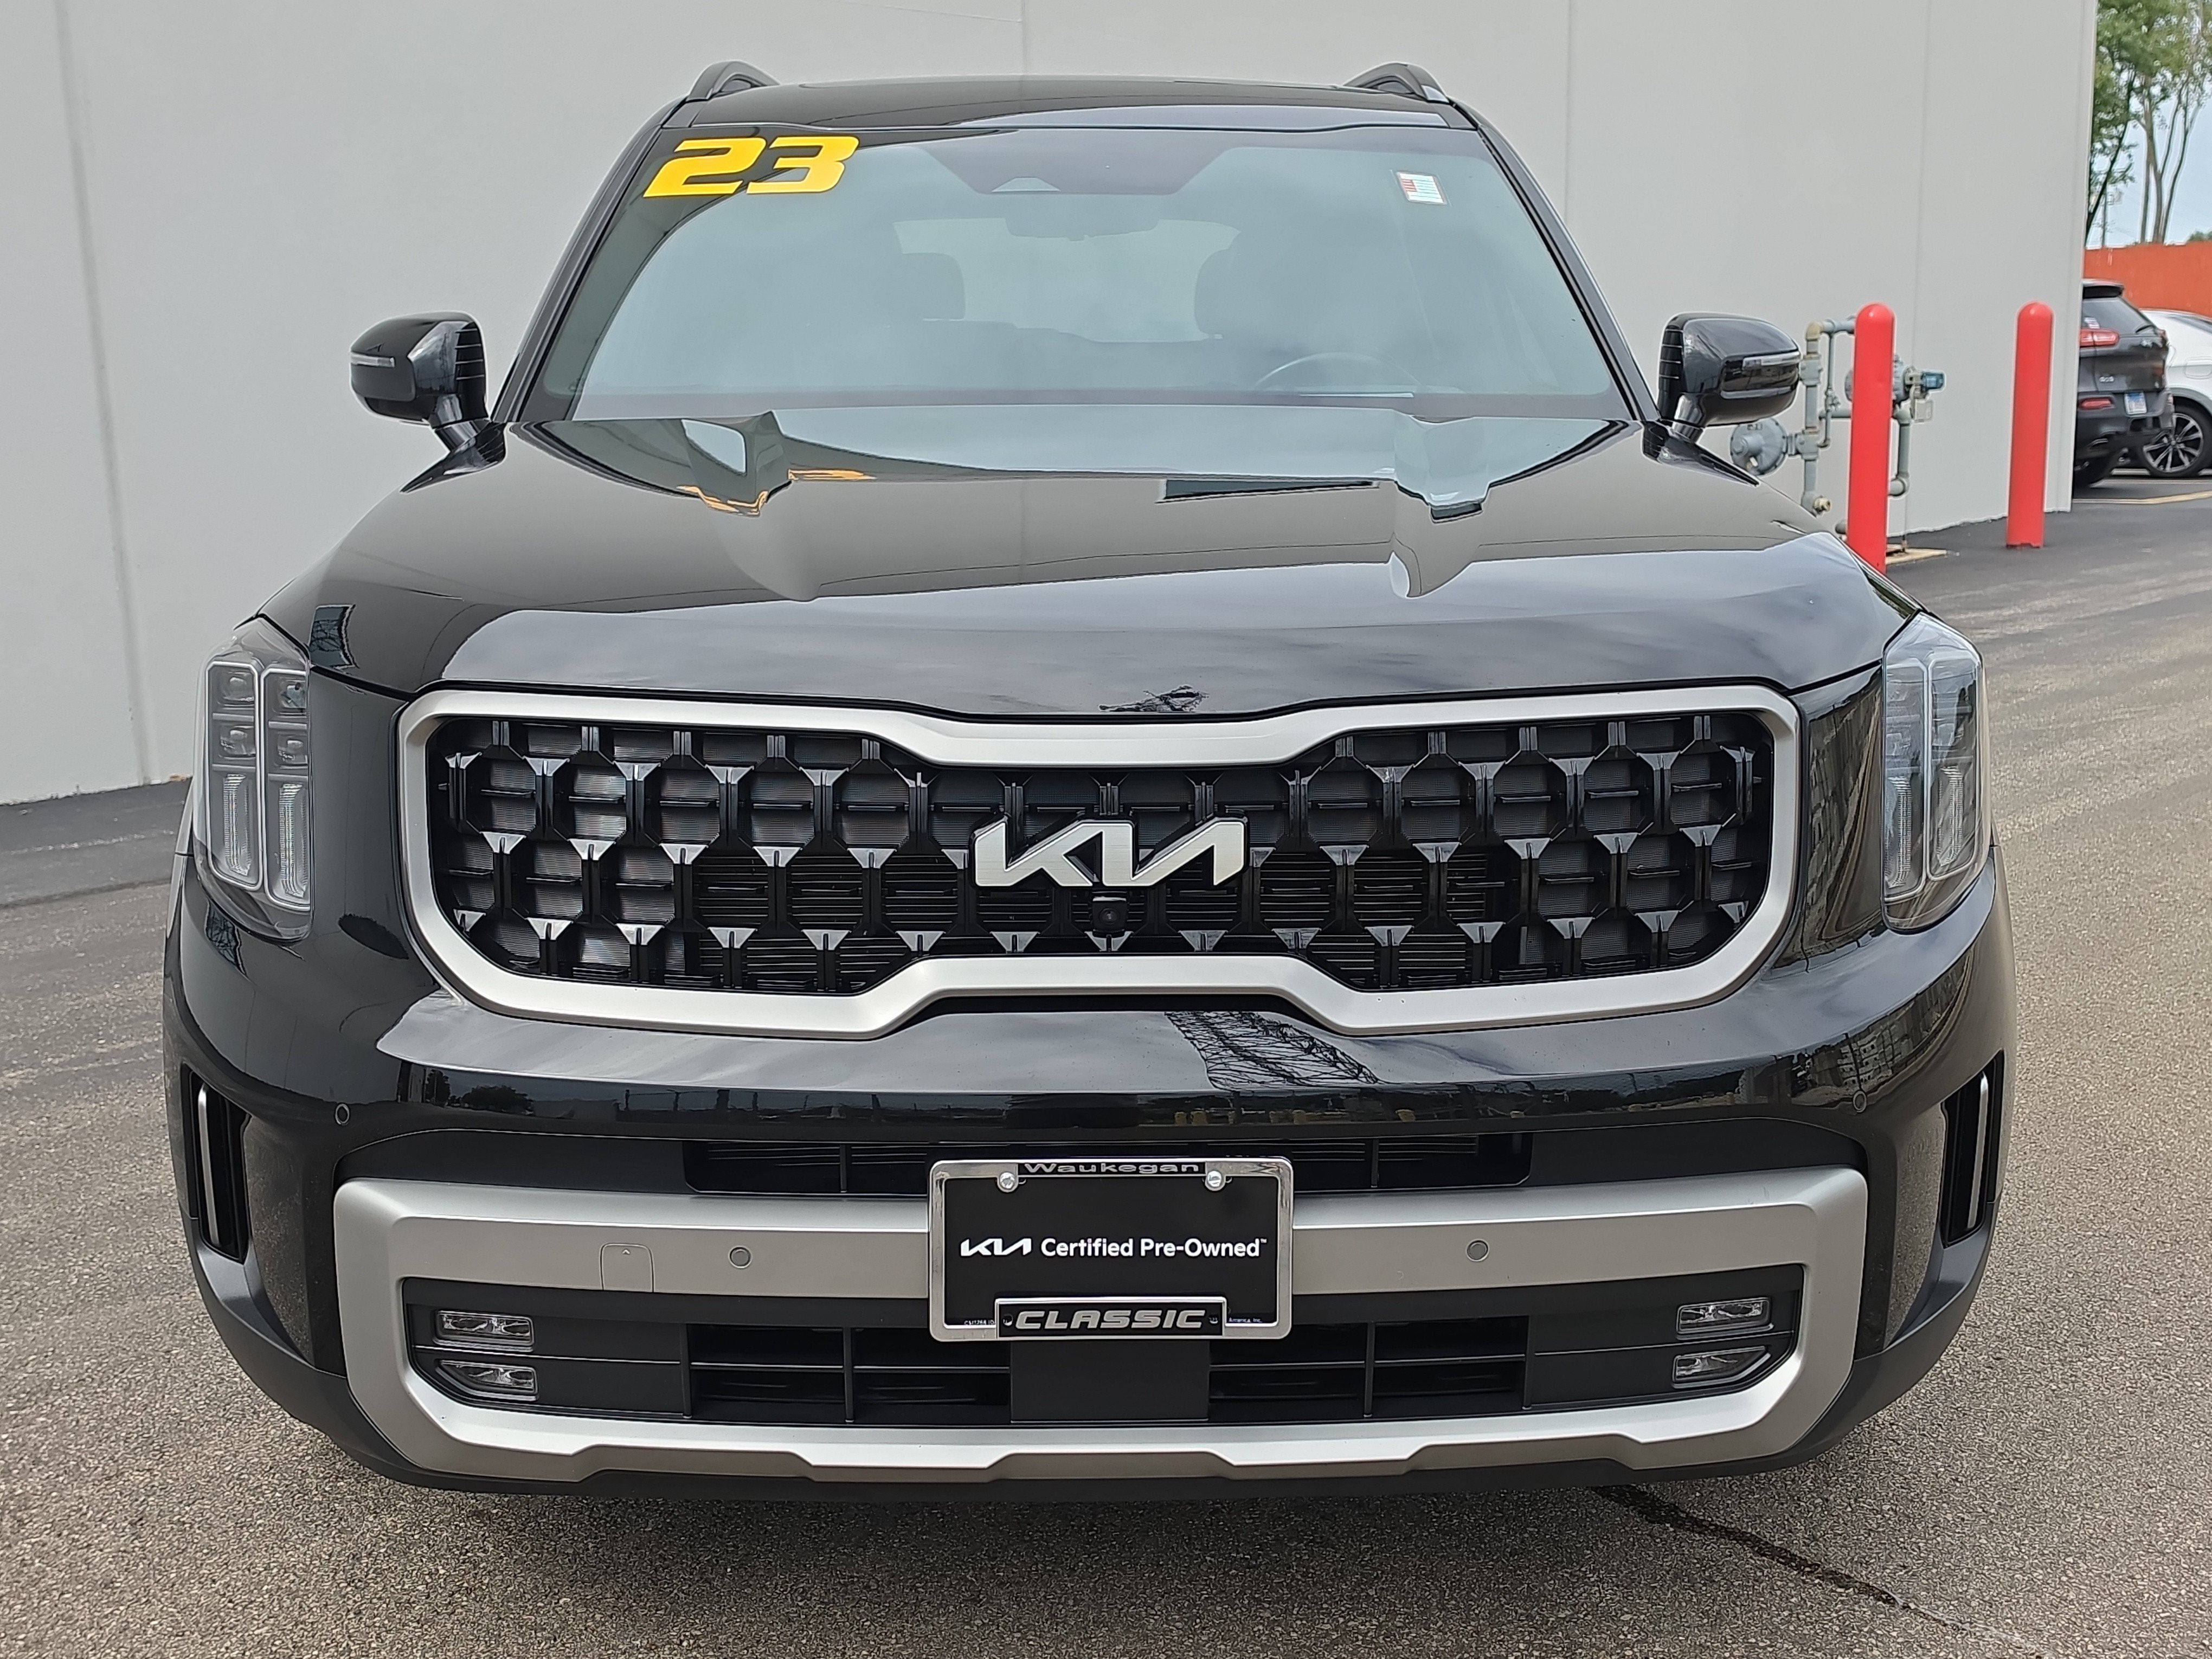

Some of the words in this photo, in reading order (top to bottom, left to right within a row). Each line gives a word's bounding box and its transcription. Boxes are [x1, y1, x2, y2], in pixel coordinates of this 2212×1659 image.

[643, 137, 860, 198] 23
[974, 822, 1244, 886] KIA
[1024, 1162, 1200, 1174] Waukegan
[960, 1238, 1032, 1257] KIA
[1040, 1238, 1133, 1257] Certified
[1015, 1310, 1206, 1330] CLASSIC
